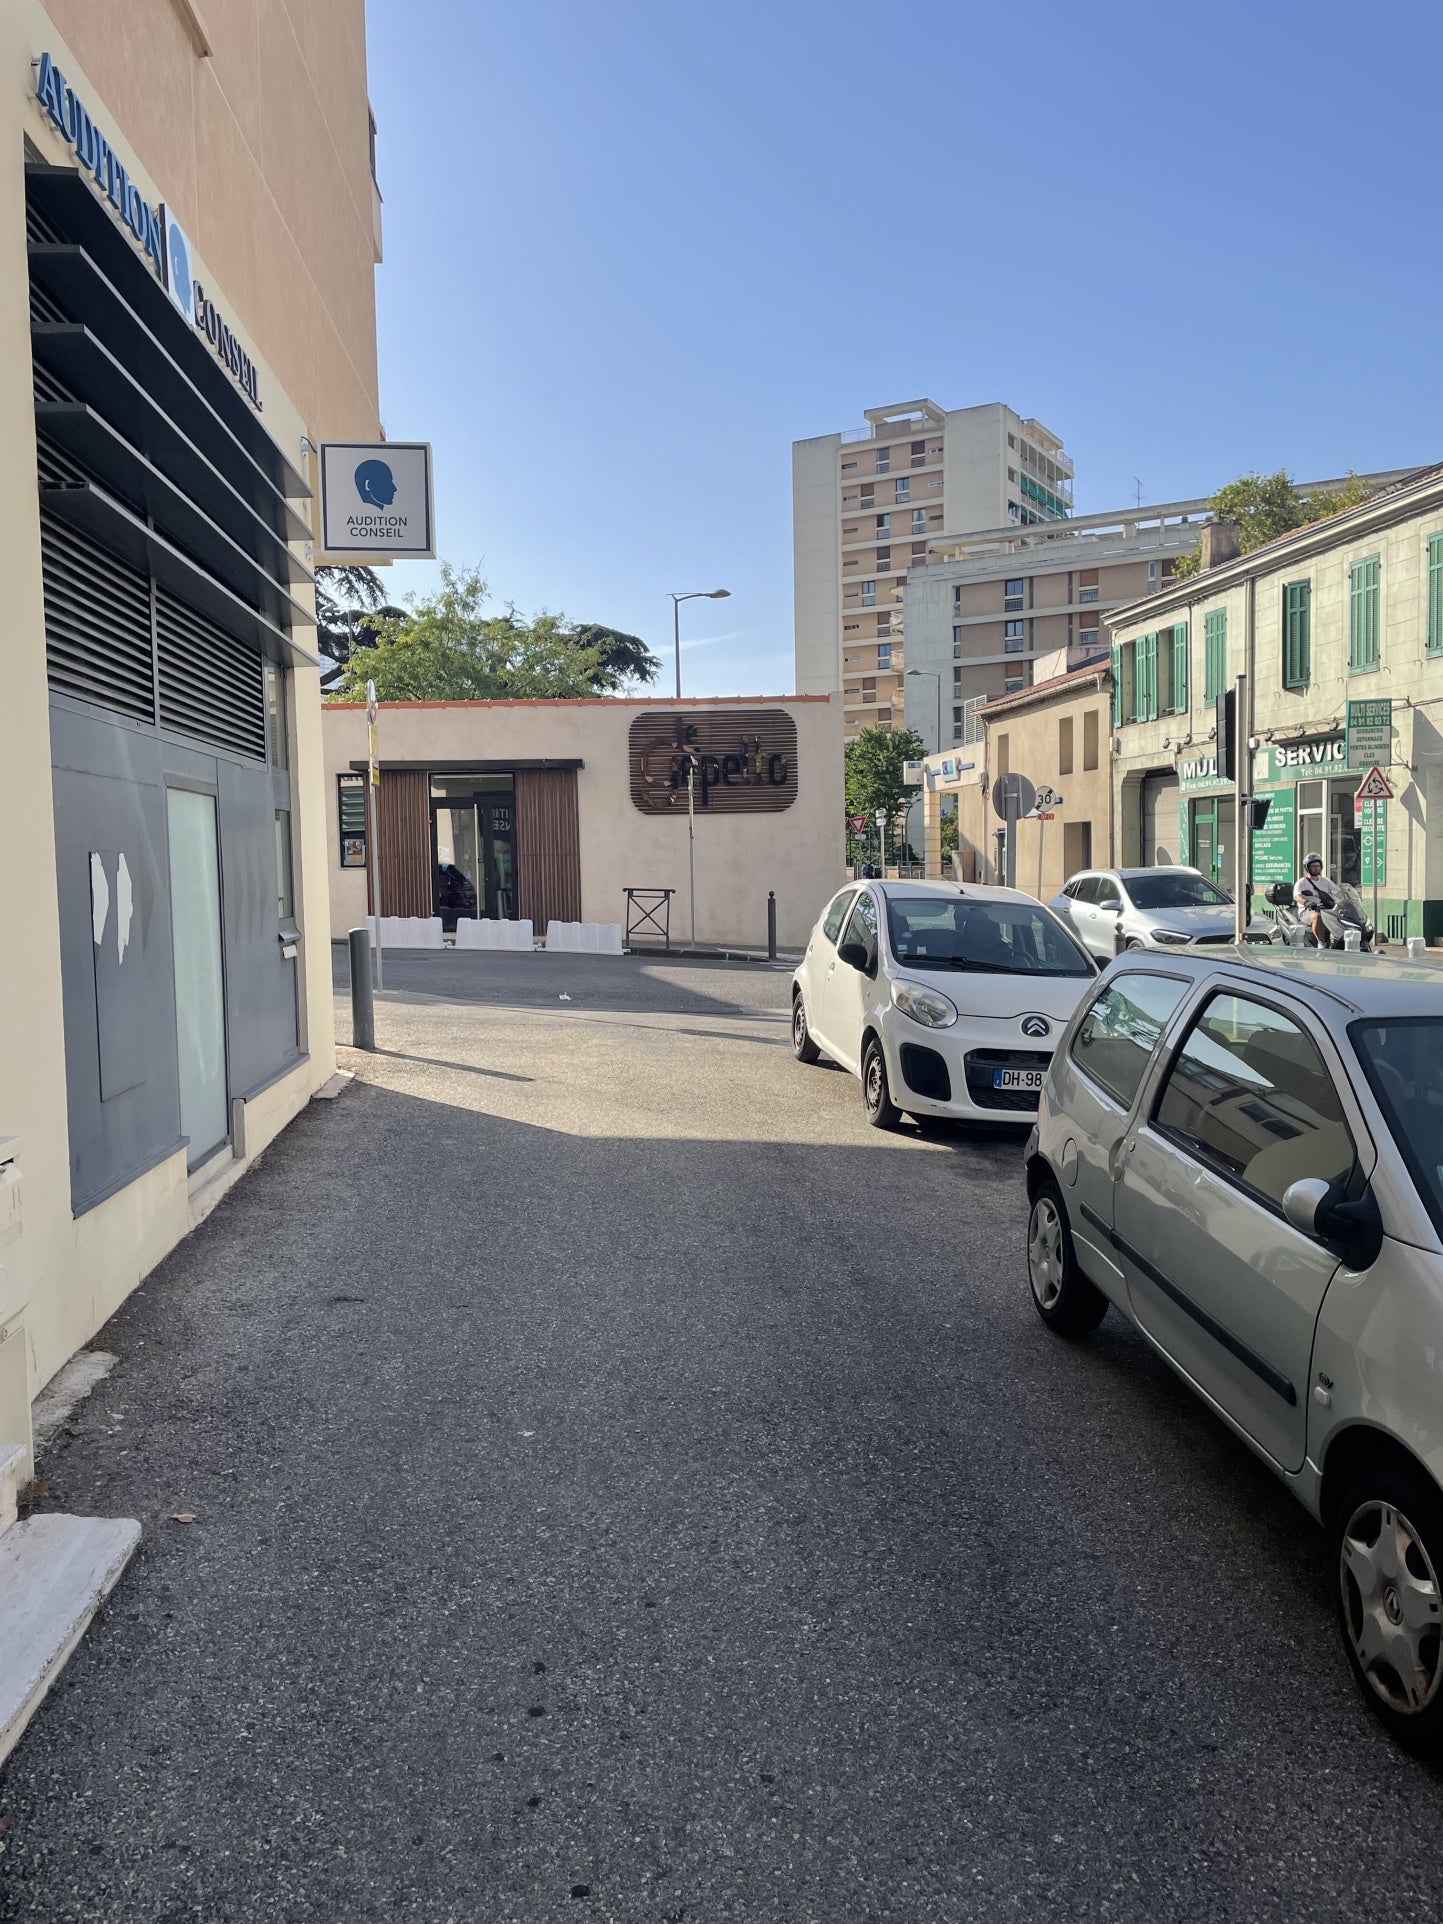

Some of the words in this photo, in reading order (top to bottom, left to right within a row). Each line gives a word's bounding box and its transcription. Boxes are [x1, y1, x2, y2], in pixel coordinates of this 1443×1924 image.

[36, 52, 163, 270] AUDITION
[193, 280, 263, 412] CONSEIL
[346, 516, 408, 527] AUDITION
[350, 527, 404, 538] CONSEIL
[1350, 703, 1365, 717] MULTI
[1366, 702, 1390, 716] SERVICES
[1350, 718, 1357, 726] 04
[1358, 718, 1365, 726] 91
[1383, 716, 1390, 725] 72
[1183, 759, 1217, 779] MUL
[1275, 740, 1345, 767] SERVIC
[1038, 794, 1052, 805] 30
[1003, 1072, 1042, 1086] DH-98
